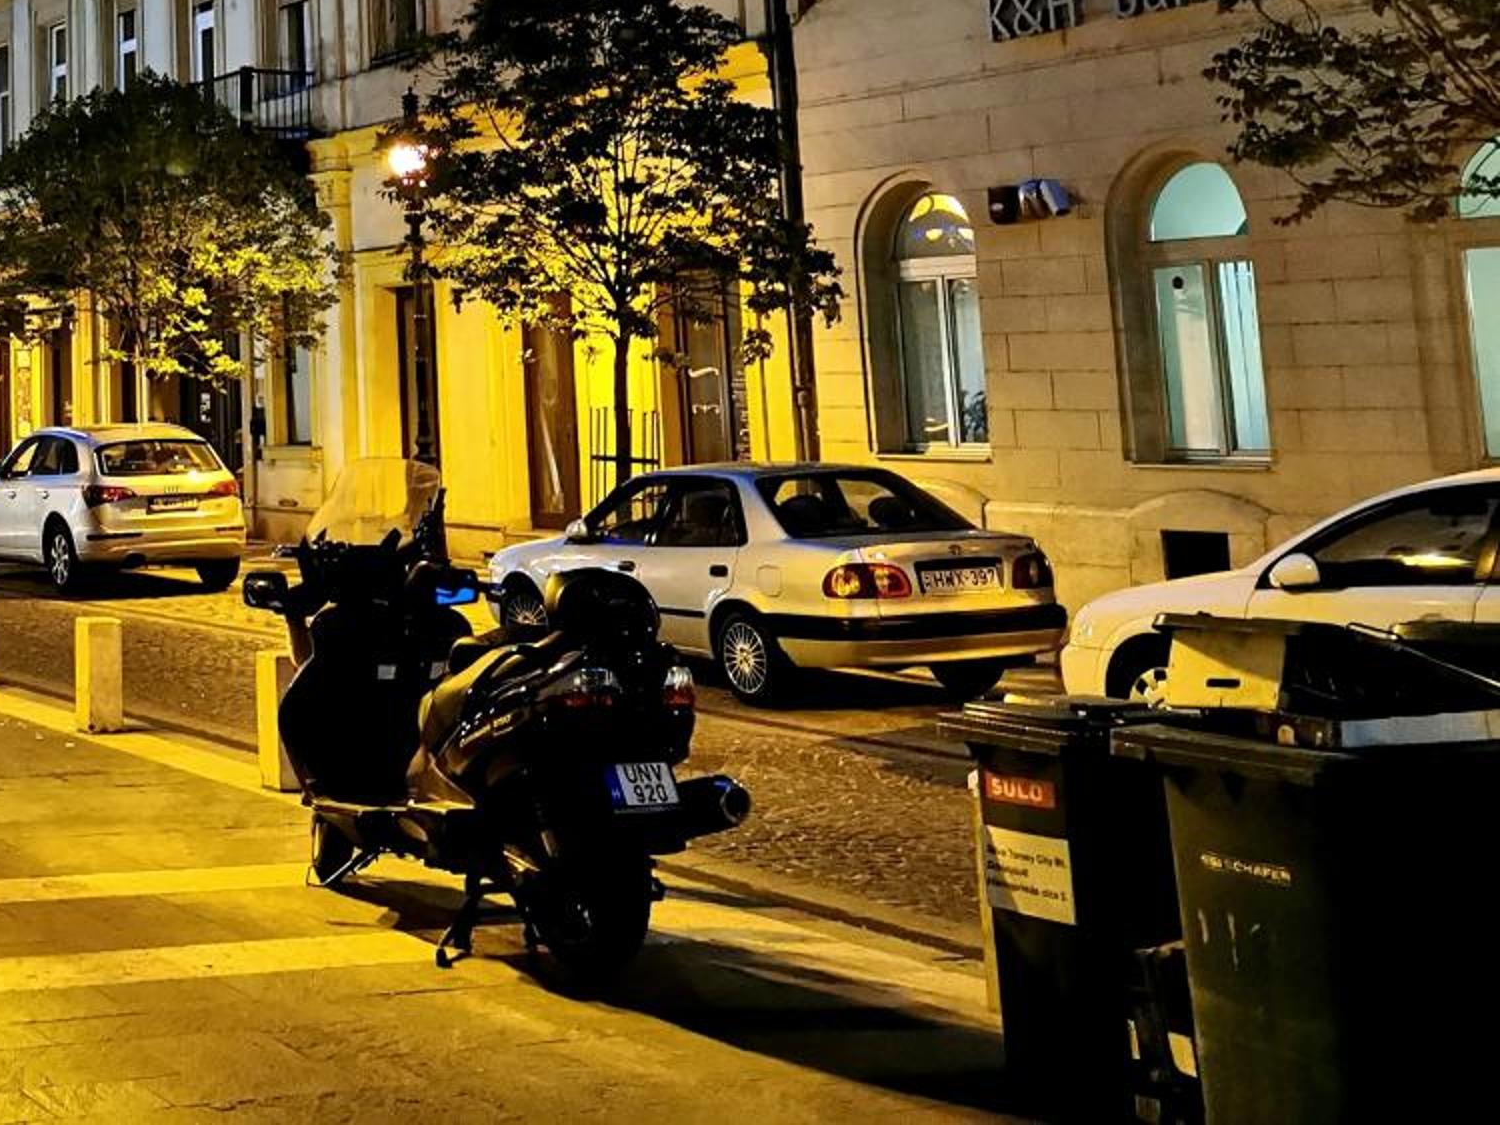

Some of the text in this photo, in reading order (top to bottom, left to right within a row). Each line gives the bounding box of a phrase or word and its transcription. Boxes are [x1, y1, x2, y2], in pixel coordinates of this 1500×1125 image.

[624, 764, 661, 784] UNV
[634, 784, 668, 803] 920
[991, 777, 1044, 802] SULO
